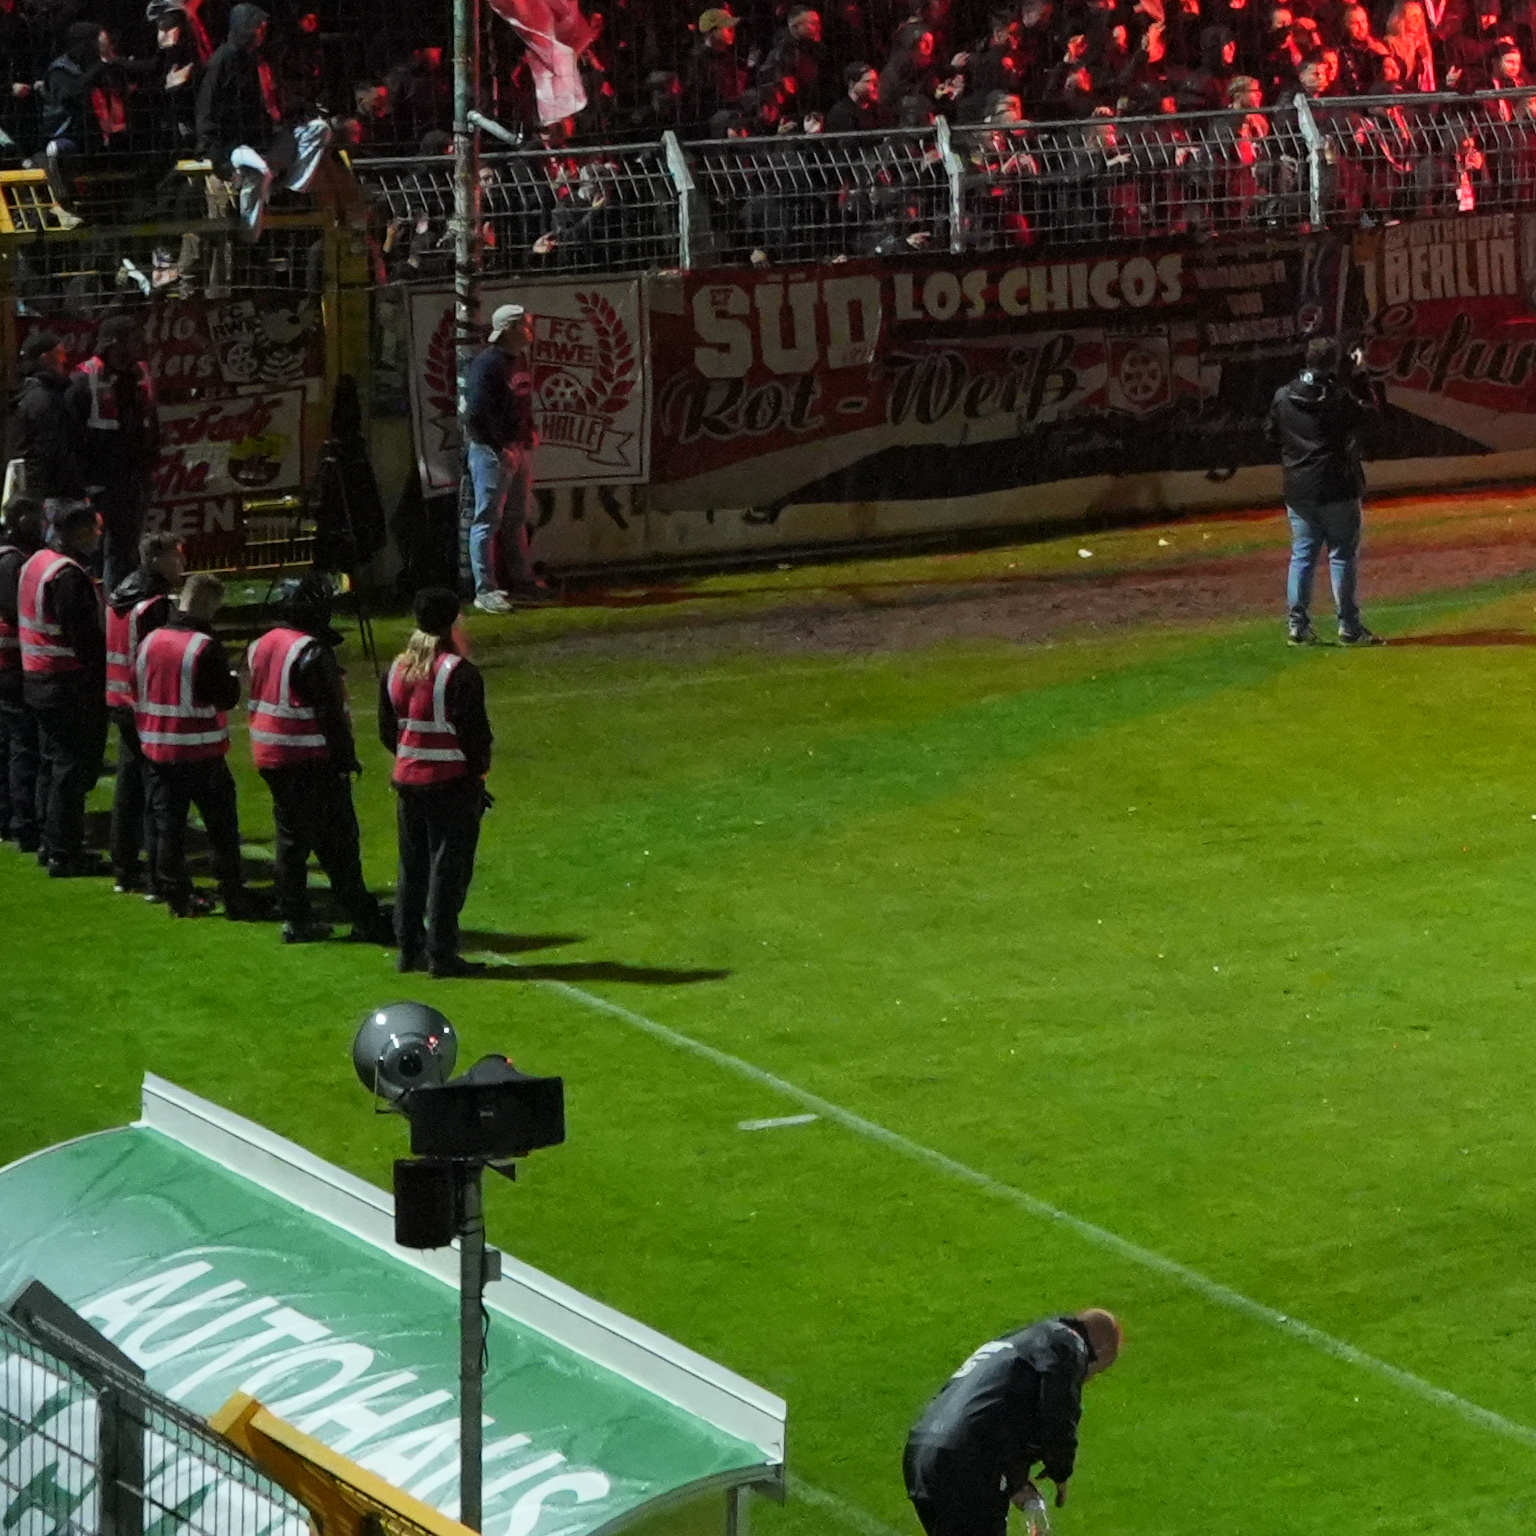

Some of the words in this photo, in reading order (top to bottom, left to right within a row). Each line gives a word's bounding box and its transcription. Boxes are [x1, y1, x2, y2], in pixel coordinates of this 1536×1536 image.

[893, 269, 988, 321] LOS
[999, 253, 1183, 316] CHICOS
[1385, 237, 1518, 305] BERLIN
[535, 341, 594, 364] RWE
[549, 320, 583, 342] FC
[692, 272, 883, 378] SÜD
[541, 413, 601, 446] HALLE
[75, 1260, 612, 1536] AUTOHAUS
